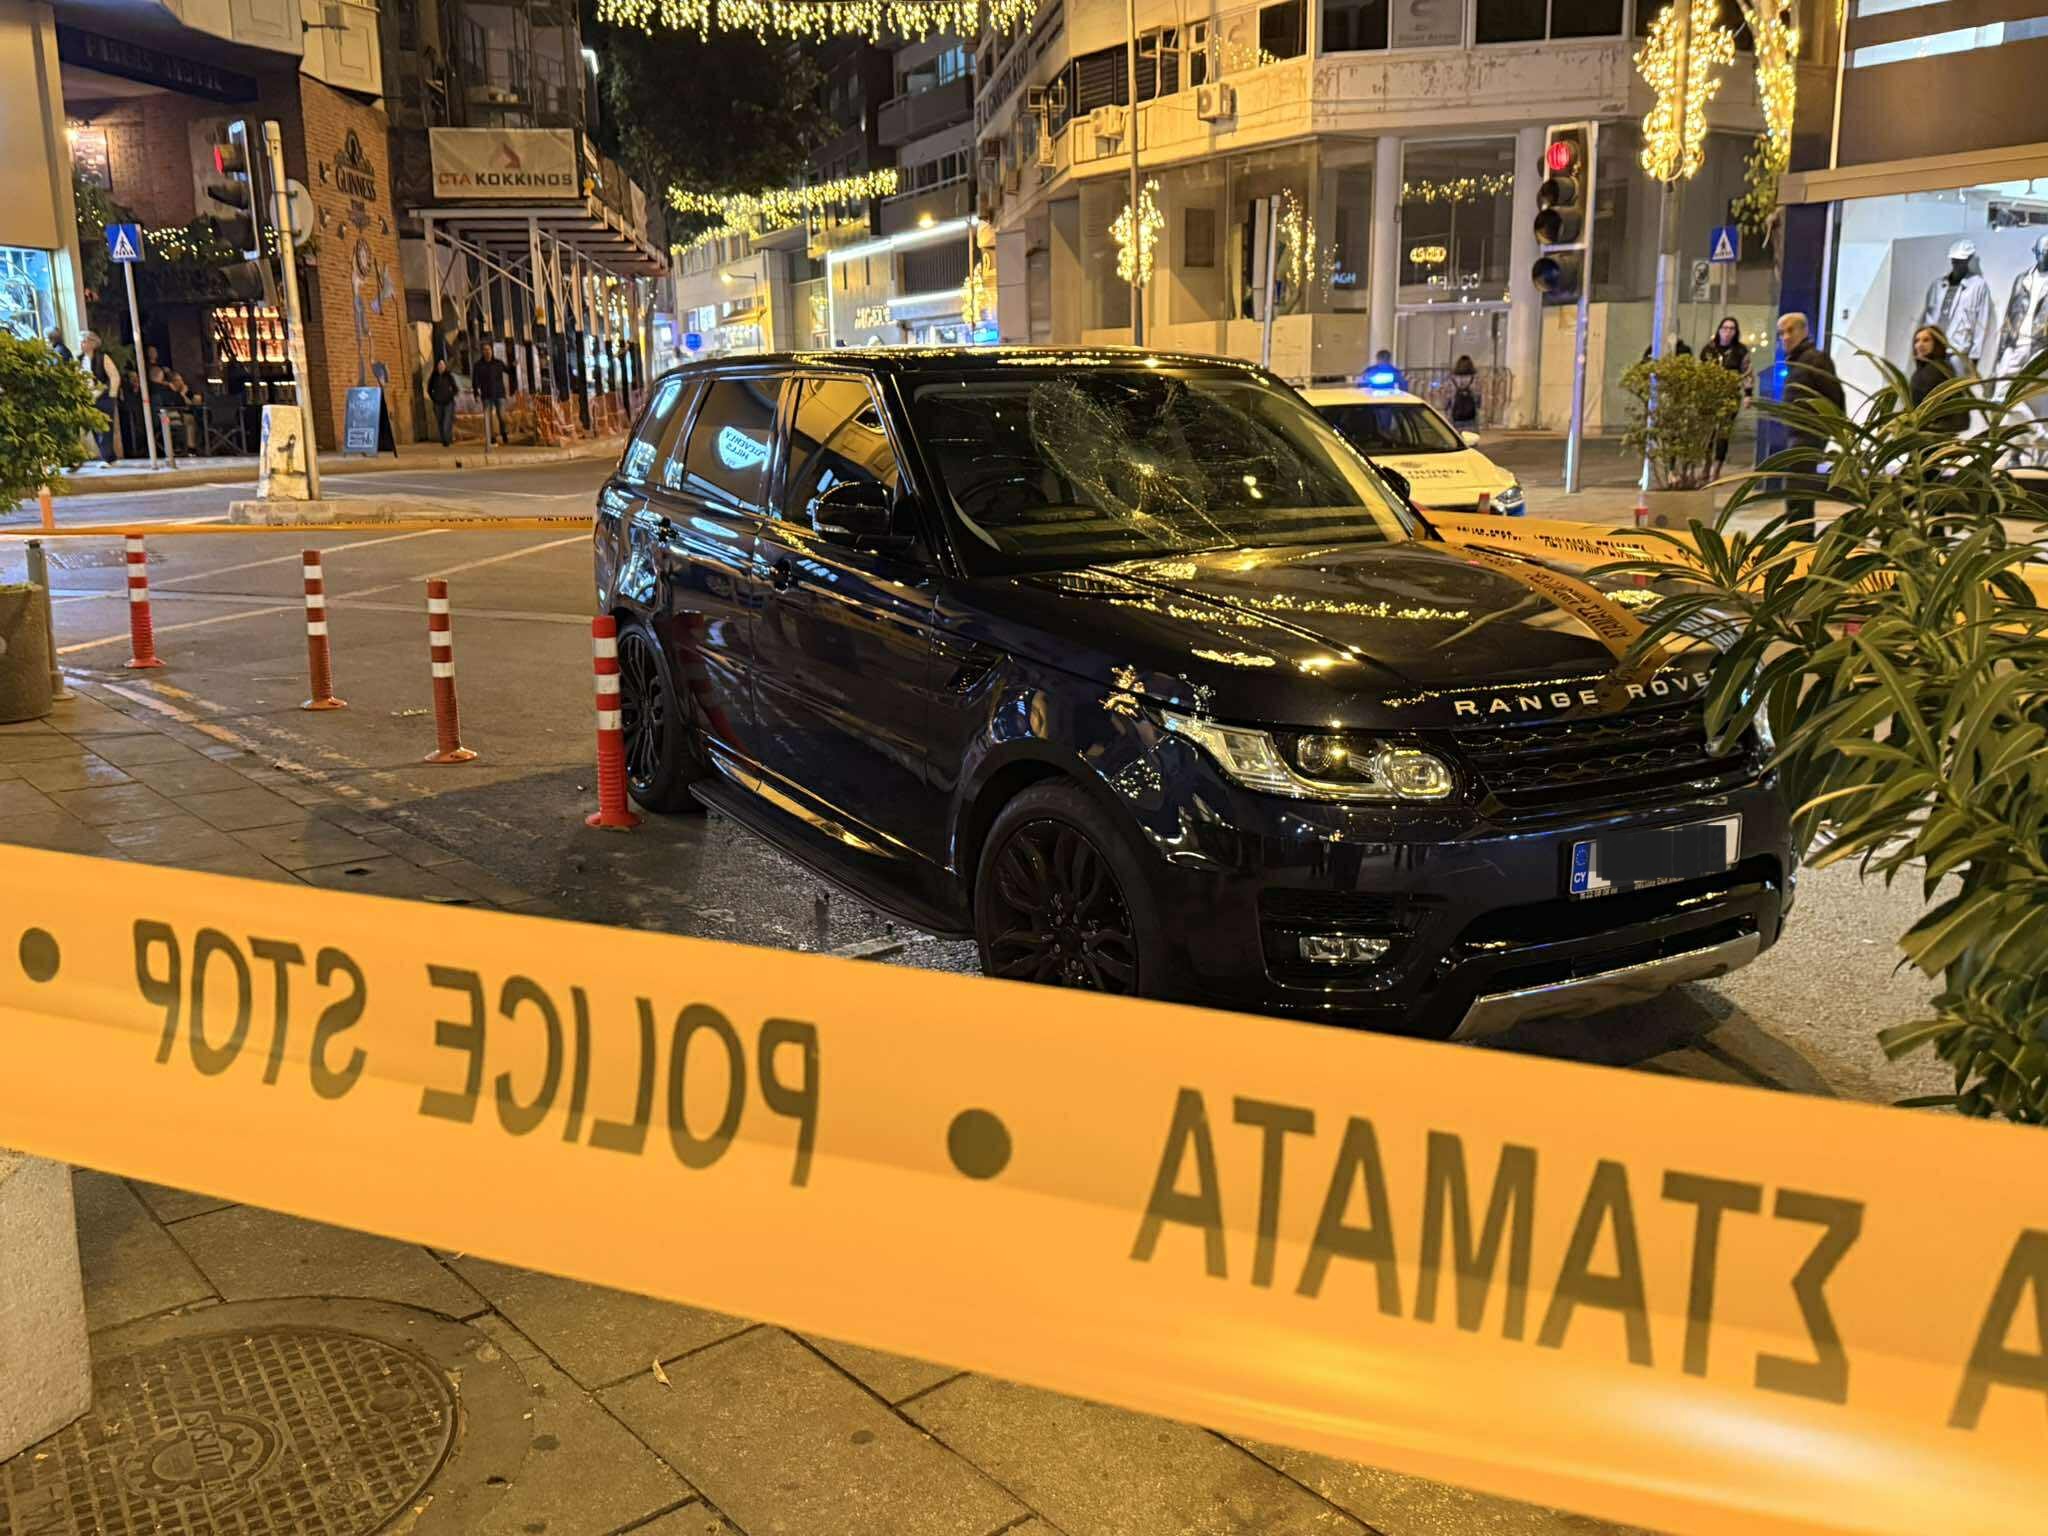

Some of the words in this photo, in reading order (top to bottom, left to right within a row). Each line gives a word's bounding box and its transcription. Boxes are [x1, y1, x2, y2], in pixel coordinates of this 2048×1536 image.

[335, 164, 377, 202] GUINNESS
[438, 172, 471, 186] CTA
[475, 172, 573, 187] KOKKINOS
[1454, 689, 1599, 716] RANGE
[1627, 668, 1717, 700] ROVE
[1574, 871, 1587, 884] CY
